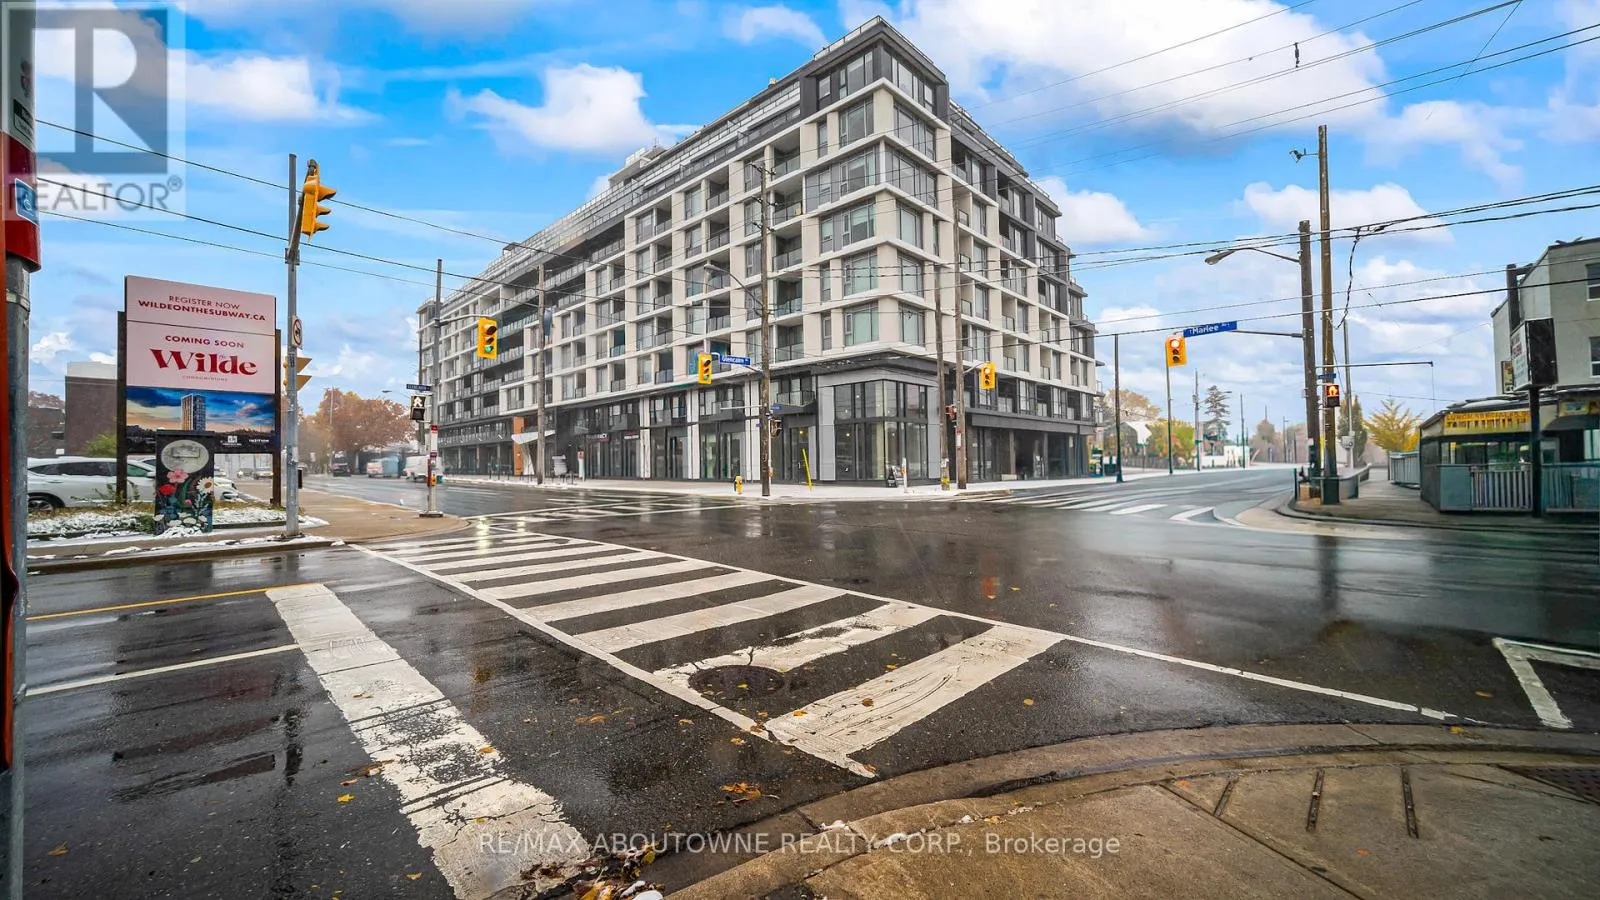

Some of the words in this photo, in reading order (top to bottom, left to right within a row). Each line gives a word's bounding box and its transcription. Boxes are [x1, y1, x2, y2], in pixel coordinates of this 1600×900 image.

[138, 299, 266, 321] WILDEONTHESUBWAY.CA
[168, 295, 212, 307] REGISTER
[215, 302, 241, 310] NOW
[1192, 324, 1219, 335] Marlee
[165, 335, 211, 346] COMING
[214, 339, 245, 349] SOON
[149, 348, 258, 376] Wilde
